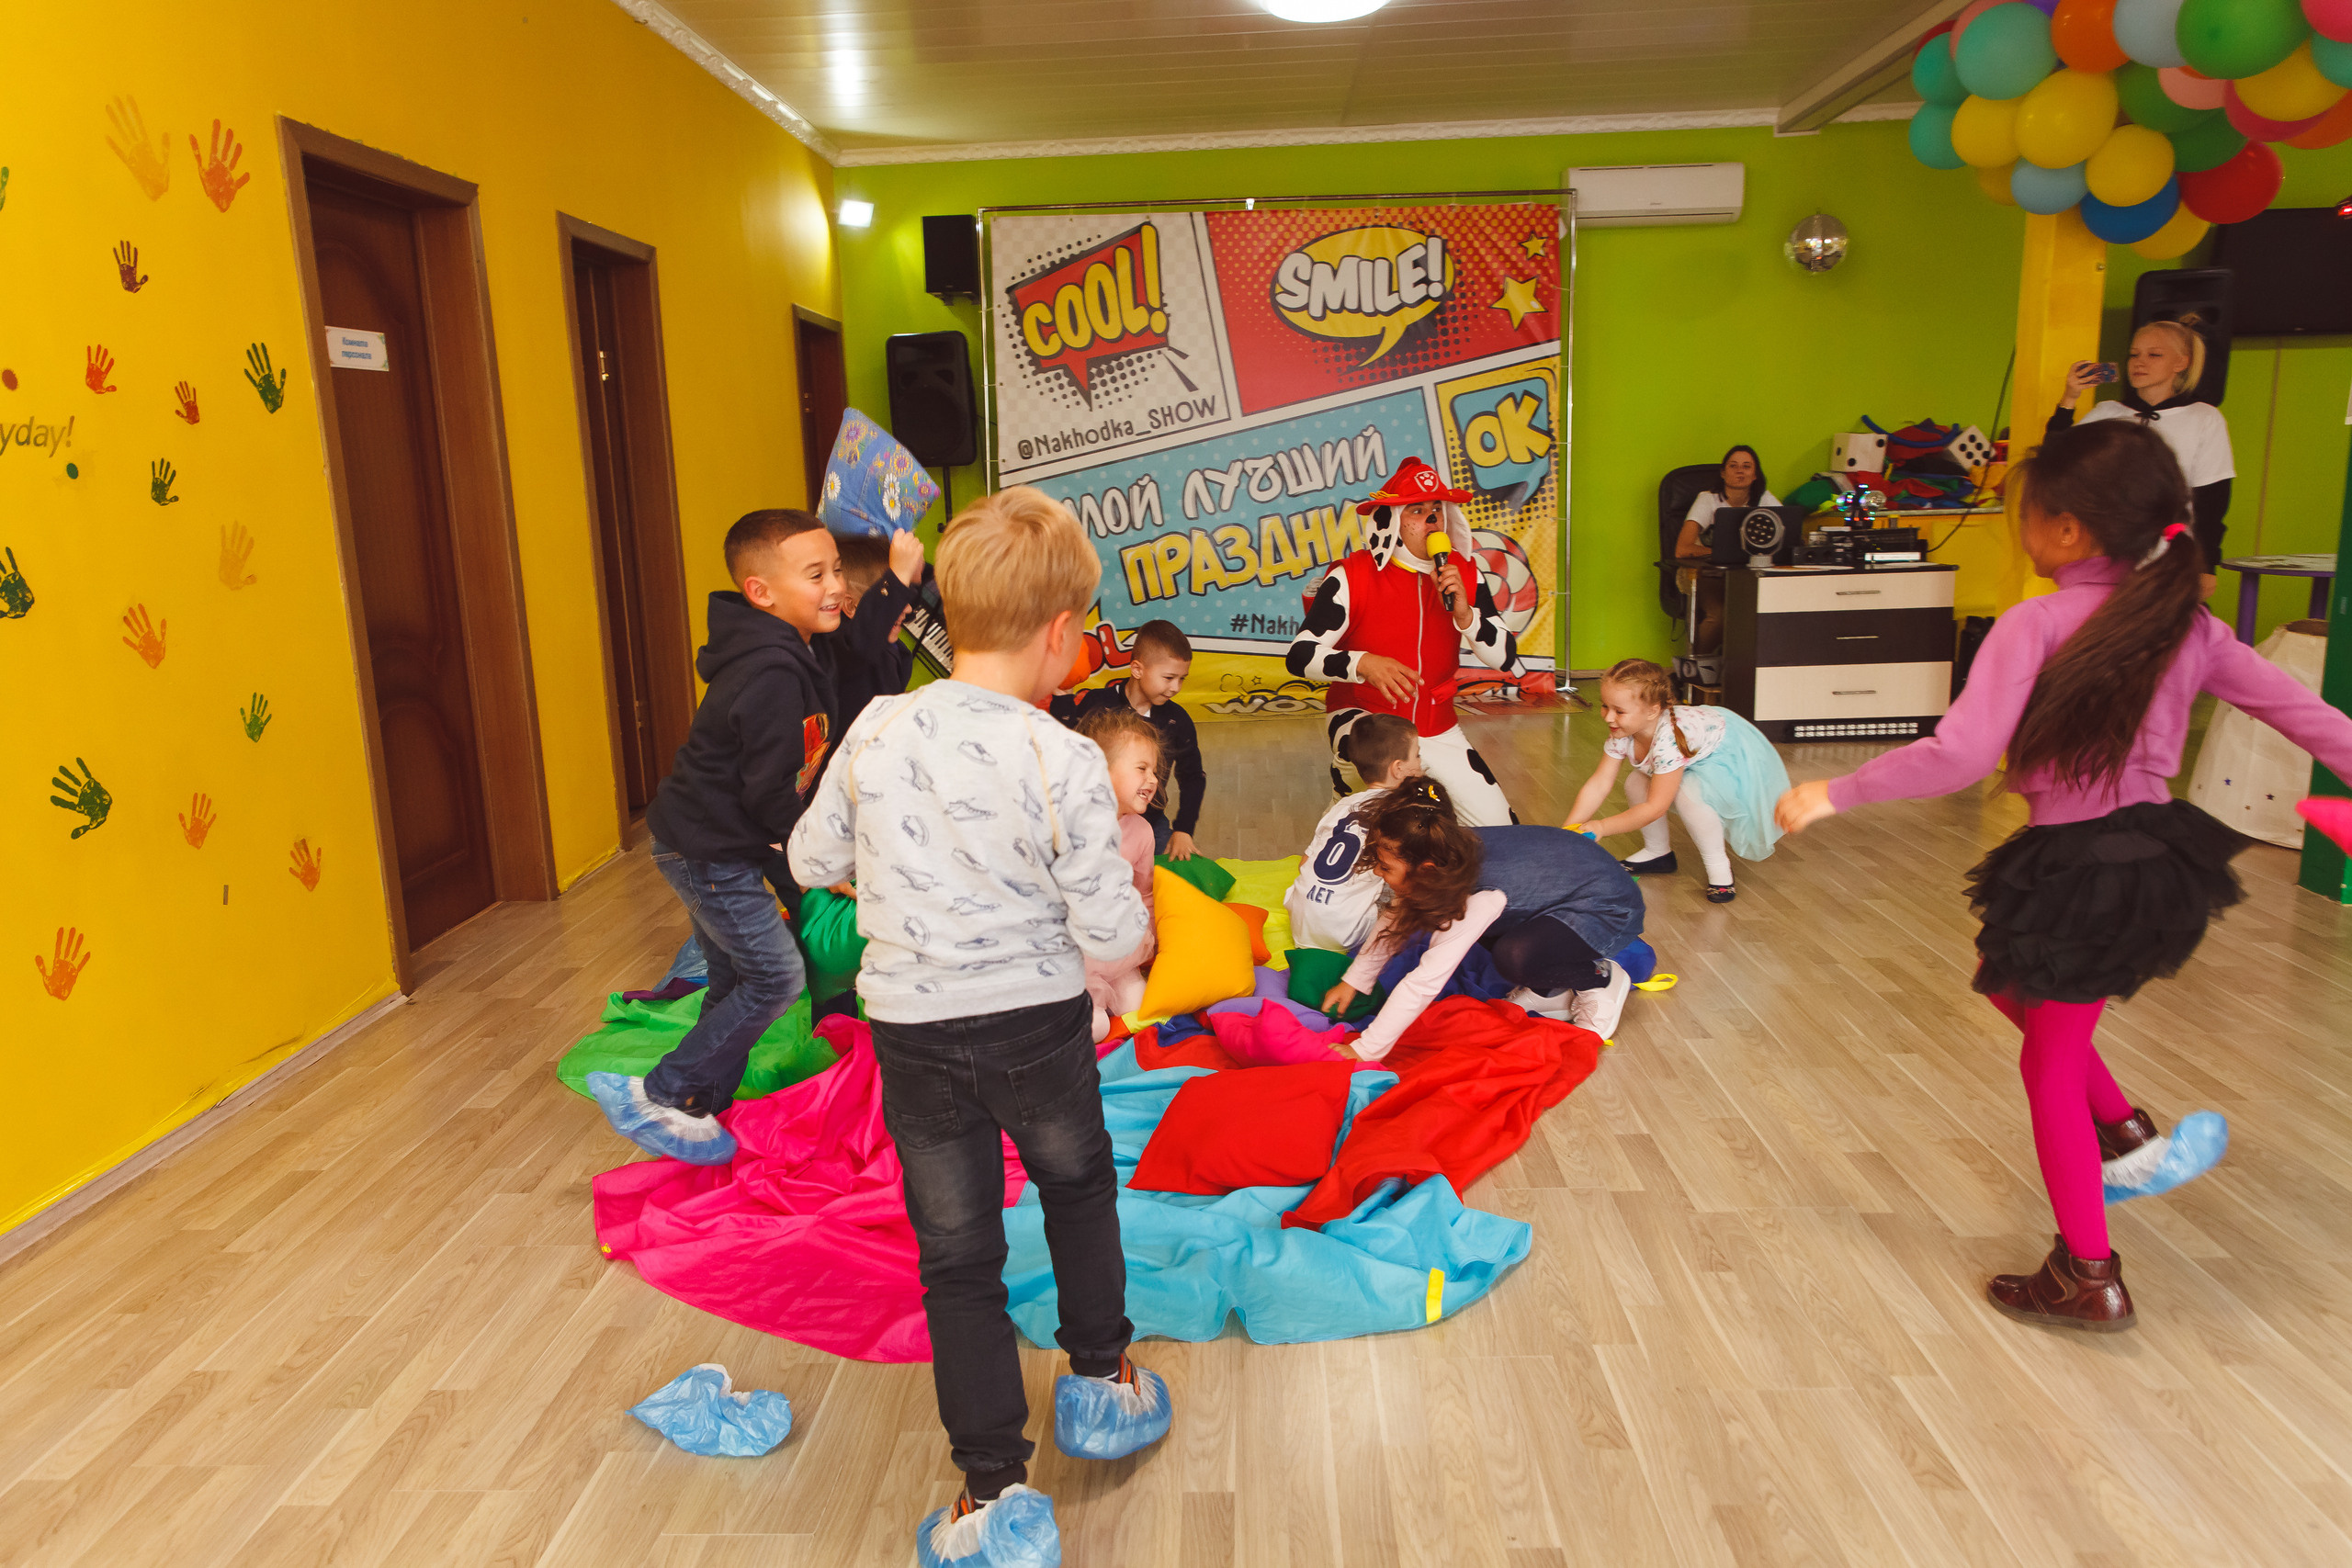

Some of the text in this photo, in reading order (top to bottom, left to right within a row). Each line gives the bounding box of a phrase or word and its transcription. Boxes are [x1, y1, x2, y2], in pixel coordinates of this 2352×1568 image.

[1022, 223, 1169, 359] COOL!
[1274, 236, 1446, 321] SMILE!
[0, 415, 75, 458] yday!
[1017, 394, 1216, 460] @Nakhodka_SHOW
[1464, 389, 1555, 468] OK
[1182, 424, 1388, 520] ЛУЧШИЙ
[1306, 885, 1335, 906] ЛЕТ
